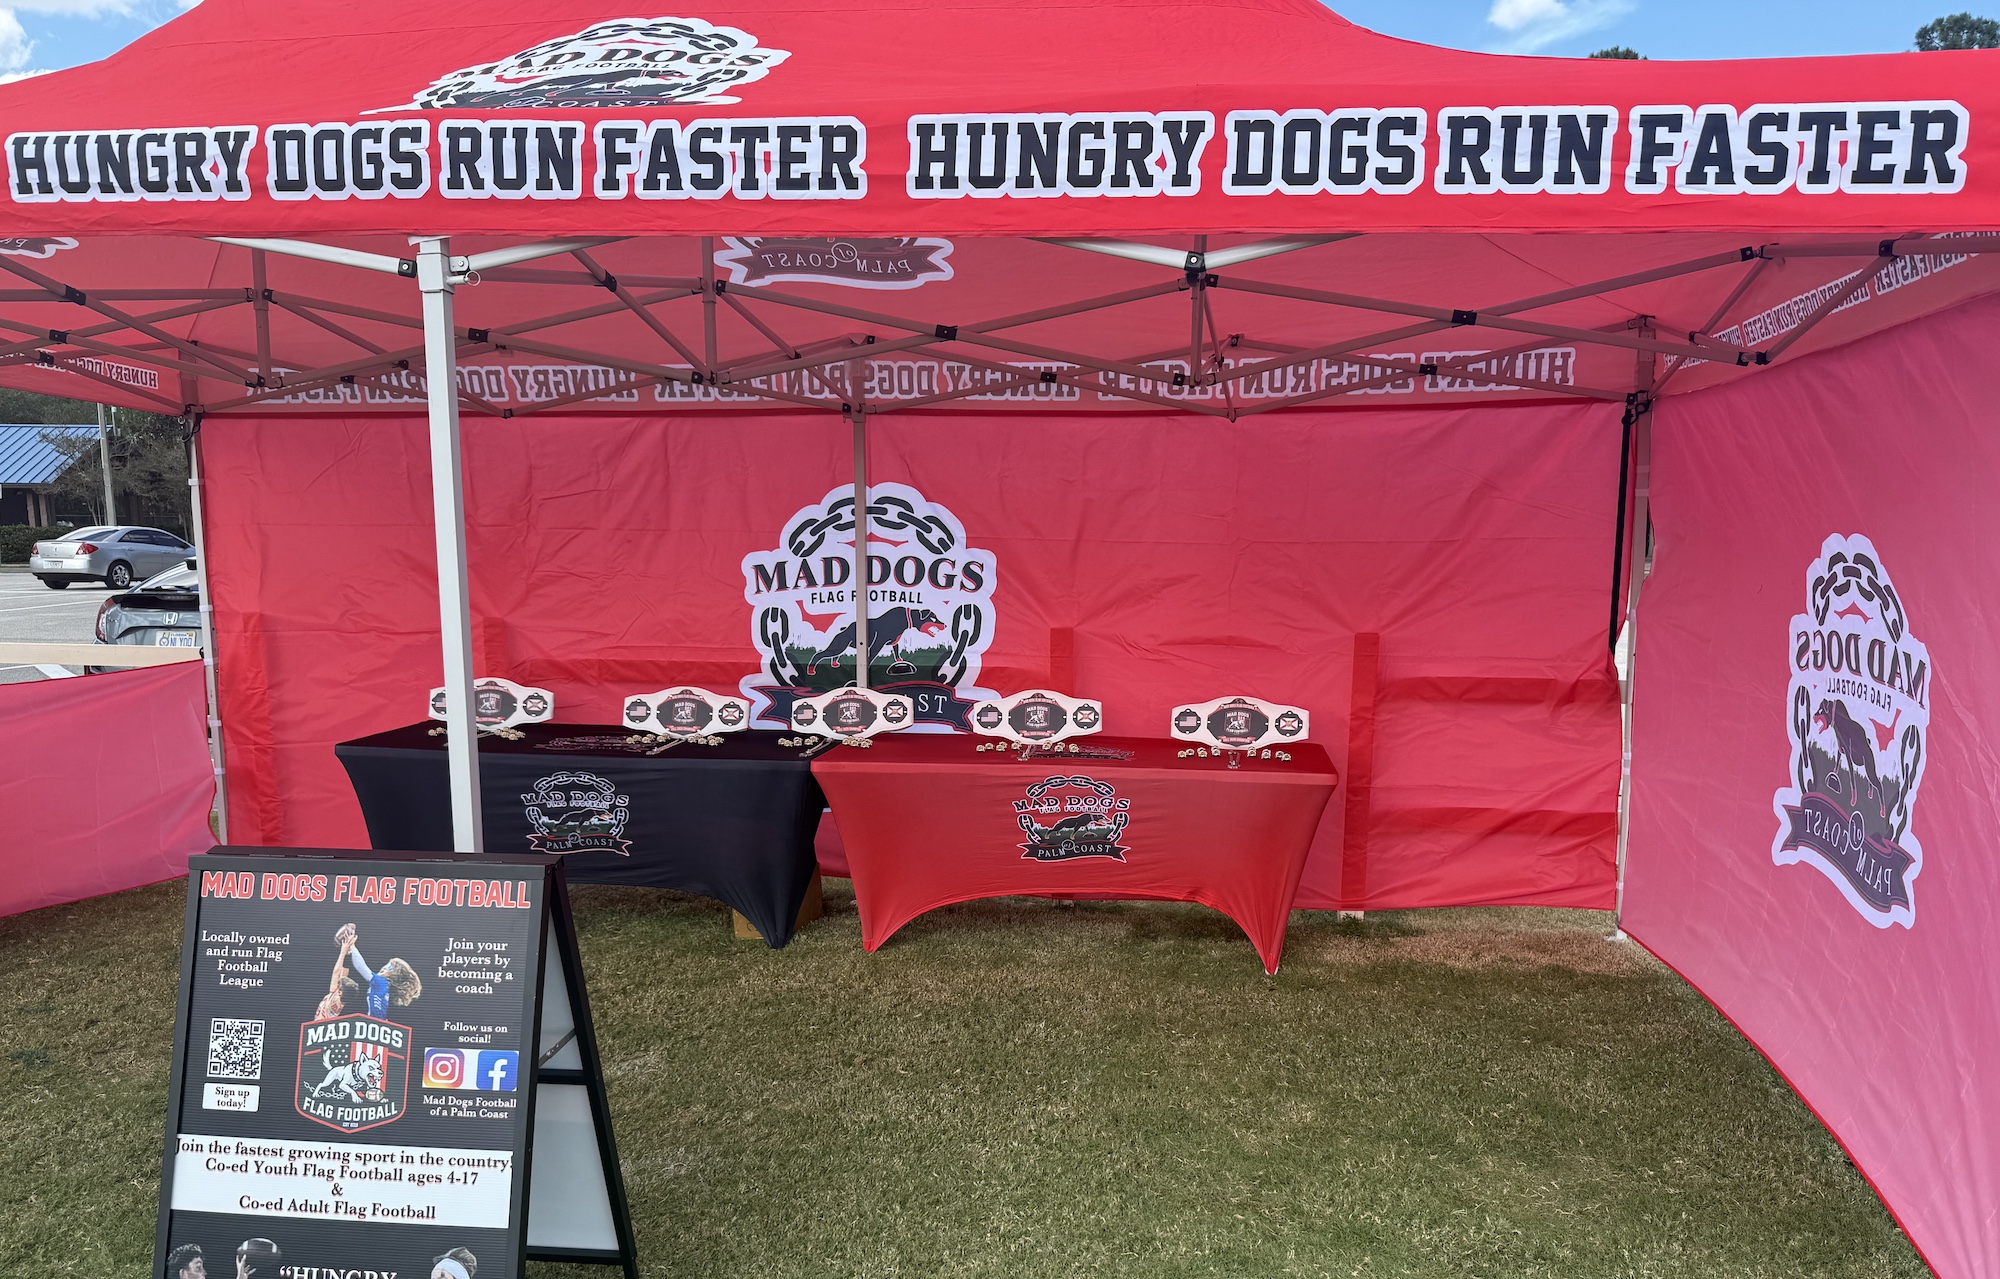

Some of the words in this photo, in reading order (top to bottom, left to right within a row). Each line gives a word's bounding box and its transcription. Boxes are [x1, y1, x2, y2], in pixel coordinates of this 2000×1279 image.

[594, 49, 771, 67] DOGS
[515, 64, 564, 75] FLAG
[914, 117, 1203, 191] HUNGRY
[1228, 115, 1417, 189] DOGS
[1444, 113, 1614, 187] RUN
[1636, 110, 1959, 187] FASTER
[14, 133, 250, 195] HUNGRY
[266, 127, 422, 192] DOGS
[448, 126, 577, 191] RUN
[601, 125, 862, 191] FASTER
[752, 556, 851, 595] MAD
[866, 556, 985, 594] DOGS
[811, 590, 844, 604] FLAG
[851, 590, 923, 604] FOTBALL
[521, 791, 566, 806] MAD
[570, 791, 629, 806] DOGS
[1012, 797, 1060, 812] MAD
[1066, 796, 1131, 810] DOGS
[546, 840, 573, 850] PALM
[579, 838, 615, 847] COAST
[1038, 848, 1066, 858] PALM
[1073, 844, 1112, 853] COAST
[201, 870, 256, 899] MAD
[260, 872, 328, 902] DOGS
[333, 874, 397, 905] FLAG
[403, 877, 531, 909] FOOTBALL
[201, 929, 247, 946] Locally
[249, 933, 290, 945] owned
[445, 937, 474, 952] Join
[477, 942, 508, 953] your
[206, 945, 228, 957] and
[231, 948, 253, 958] run
[256, 946, 283, 962] Flag
[443, 952, 491, 968] players
[494, 953, 511, 969] by
[217, 959, 268, 973] Football
[219, 973, 264, 990] League
[438, 966, 502, 983] becoming
[505, 972, 514, 981] a
[455, 982, 493, 995] coach
[306, 1021, 350, 1047] MAD
[354, 1020, 404, 1048] DOGS
[443, 1021, 478, 1032] Follow
[480, 1025, 493, 1033] us
[458, 1033, 491, 1044] social!
[214, 1086, 235, 1099] Sign
[237, 1089, 250, 1099] up
[217, 1098, 247, 1110] today!
[303, 1096, 334, 1119] FLAG
[337, 1101, 398, 1122] FOOTBALL
[422, 1094, 446, 1105] Mad
[447, 1096, 473, 1108] Dogs
[475, 1097, 517, 1108] Football
[429, 1107, 441, 1116] of
[450, 1107, 477, 1118] Palm
[479, 1108, 509, 1119] Coast
[175, 1137, 204, 1155] Join
[208, 1140, 231, 1154] the
[235, 1141, 285, 1158] fastest
[288, 1146, 351, 1165] growing
[355, 1152, 396, 1166] sport
[400, 1150, 415, 1164] in
[420, 1152, 444, 1166] the
[205, 1157, 249, 1173] Co-ed
[254, 1160, 298, 1176] Youth
[302, 1163, 336, 1182] Flag
[339, 1165, 403, 1182] Football
[407, 1173, 442, 1186] ages
[446, 1171, 479, 1185] 4-17
[331, 1182, 344, 1197] &
[239, 1194, 283, 1211] Co-ed
[287, 1197, 330, 1214] Adult
[334, 1200, 367, 1219] Flag
[371, 1203, 436, 1219] Football
